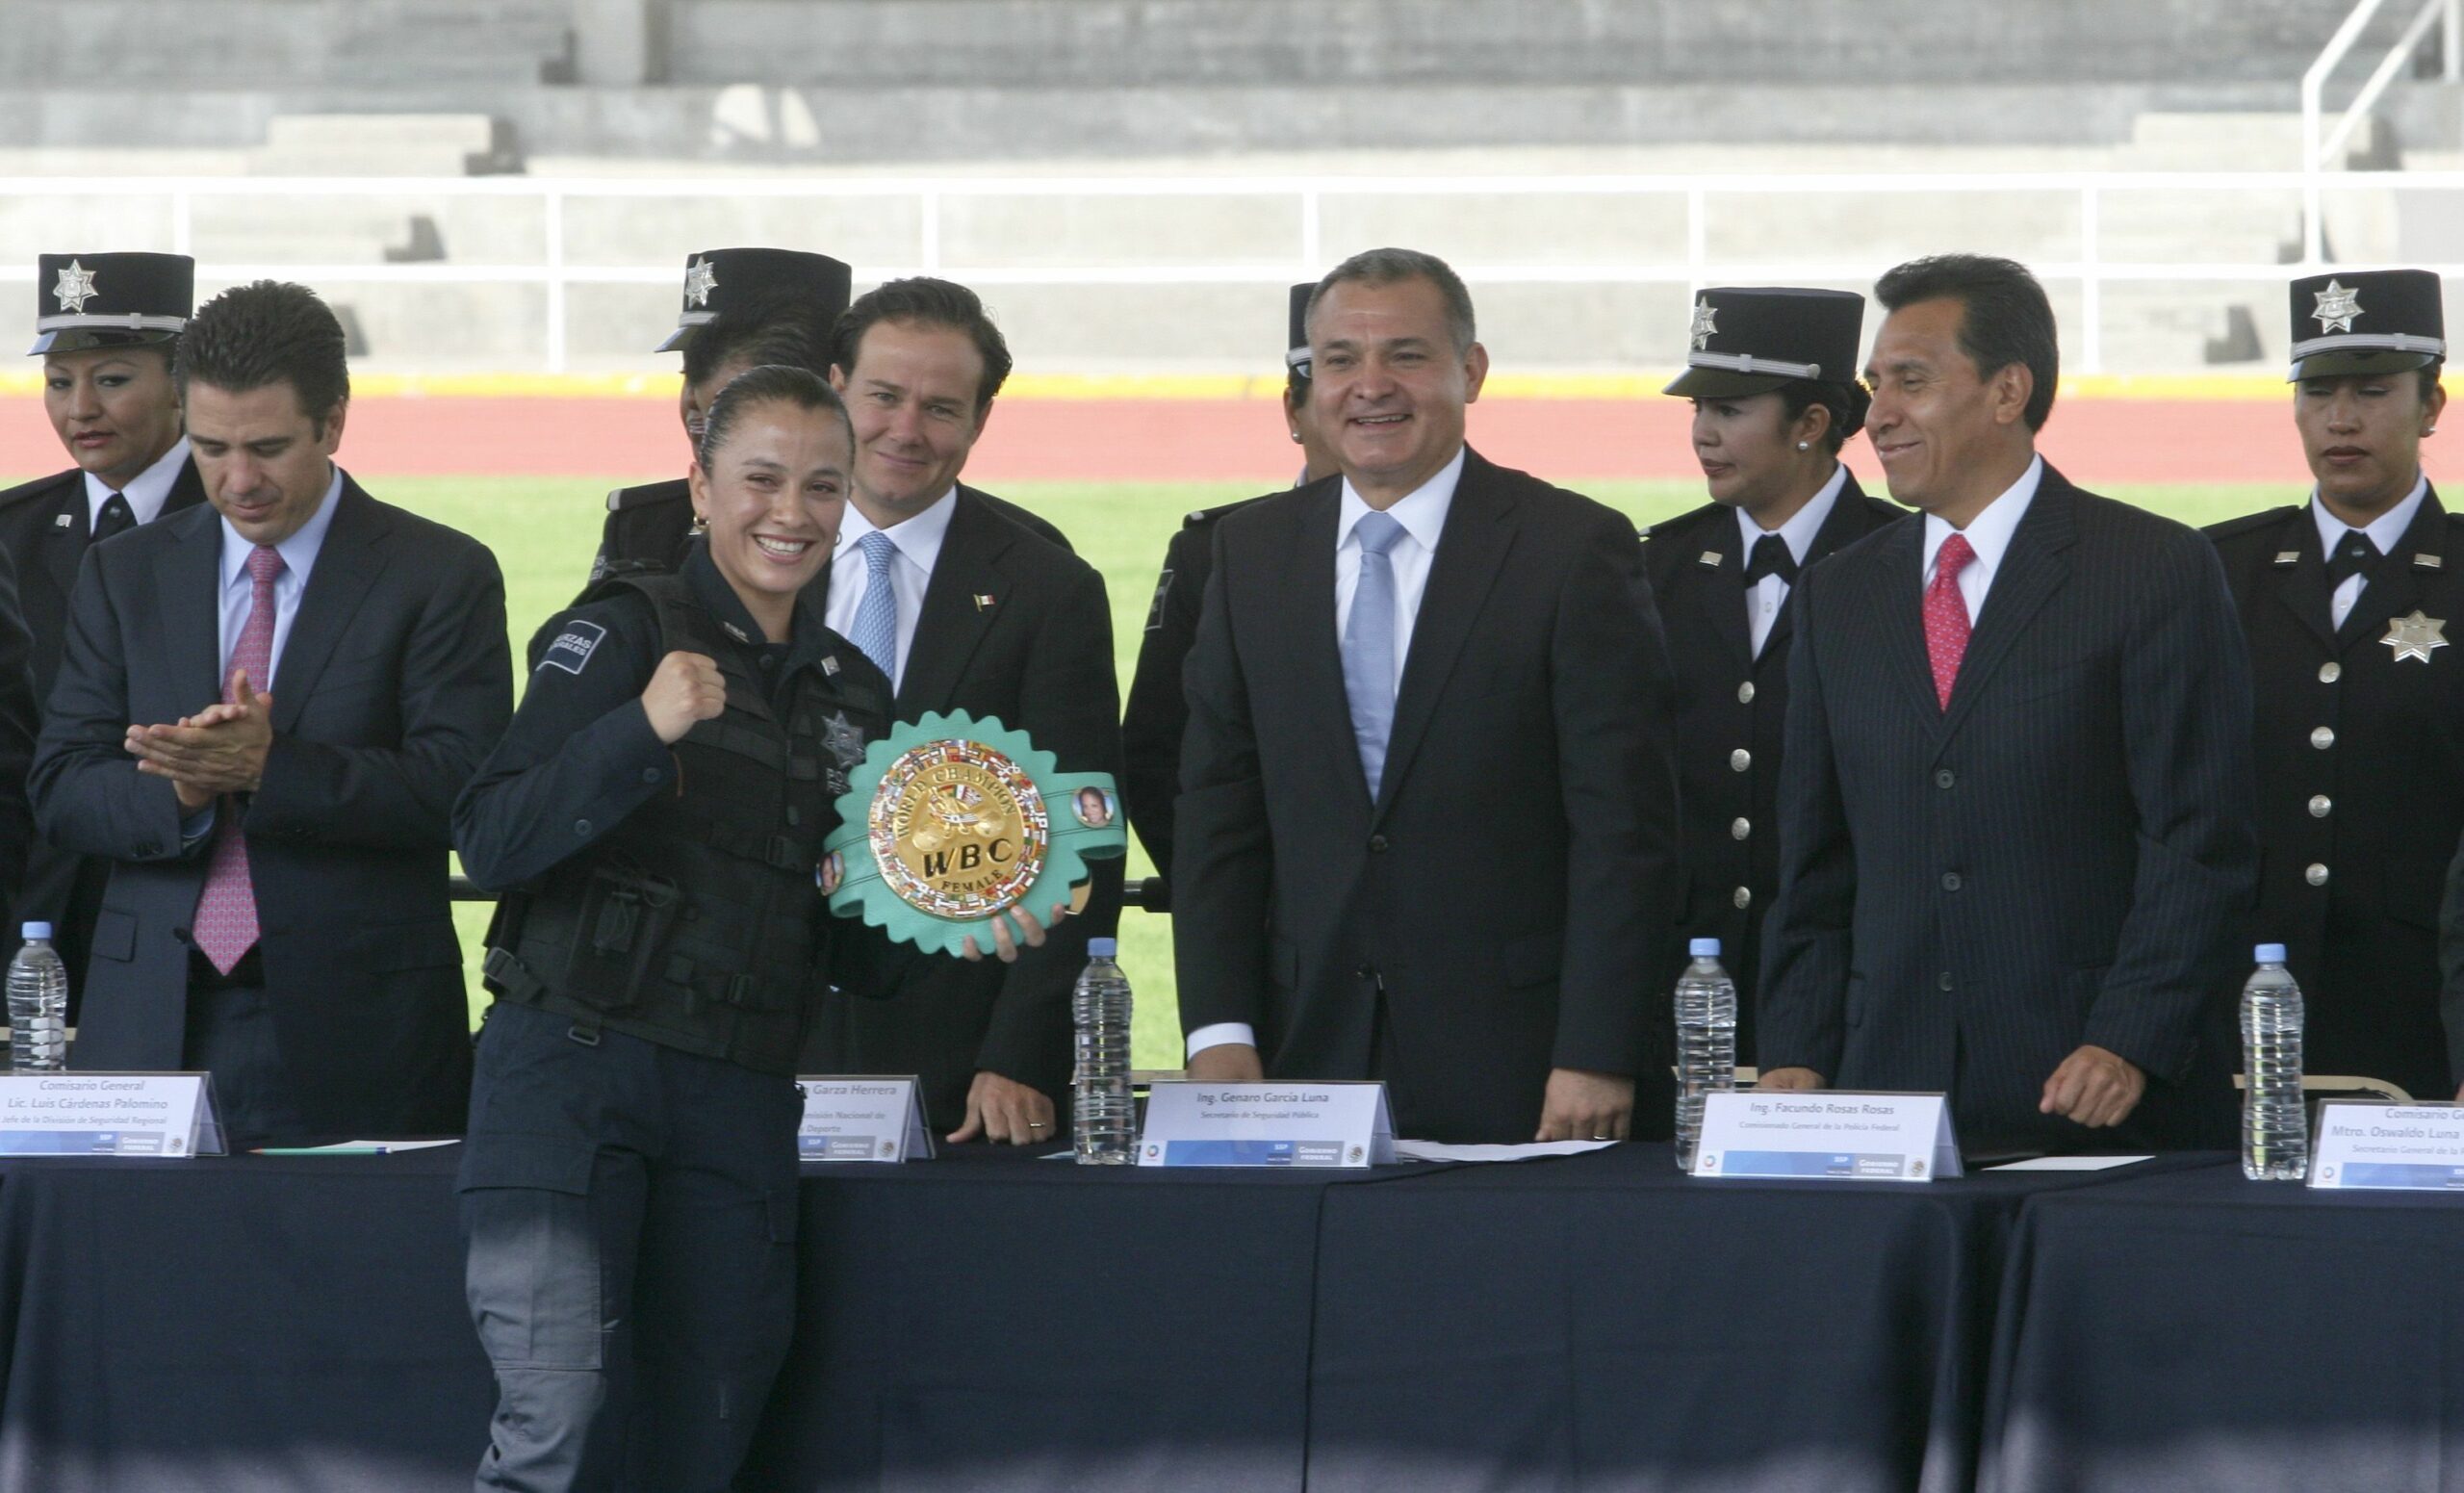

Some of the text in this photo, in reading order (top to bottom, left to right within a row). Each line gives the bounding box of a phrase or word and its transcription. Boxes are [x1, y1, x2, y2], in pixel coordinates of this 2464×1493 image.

[895, 781, 927, 839] WORLD
[932, 767, 1017, 816] CHAMPION
[922, 838, 1014, 880] WBC
[941, 869, 1003, 892] FEMALE
[39, 1080, 146, 1091] Comisario General
[813, 1084, 847, 1095] Garza
[850, 1084, 897, 1095] Herrera
[8, 1097, 169, 1109] Lic. Luis Cárdenas Palomino
[1196, 1092, 1329, 1106] Ing. Genaro García Luna
[1750, 1102, 1895, 1116] Ing. Facundo Rosas Rosas
[2385, 1107, 2449, 1120] Comisario
[834, 1111, 874, 1120] Nacional
[874, 1111, 886, 1120] de
[1242, 1110, 1251, 1119] de
[1252, 1110, 1290, 1120] Seguridad
[21, 1116, 32, 1124] de
[77, 1116, 88, 1124] de
[89, 1116, 130, 1126] Seguridad
[132, 1116, 167, 1126] Regional
[1792, 1121, 1821, 1130] General
[1870, 1123, 1900, 1132] Federal
[807, 1125, 842, 1134] Deporte
[2331, 1125, 2460, 1139] Mtro. Oswaldo Luna
[2400, 1145, 2435, 1154] General
[2436, 1145, 2448, 1155] de
[2450, 1146, 2458, 1155] la
